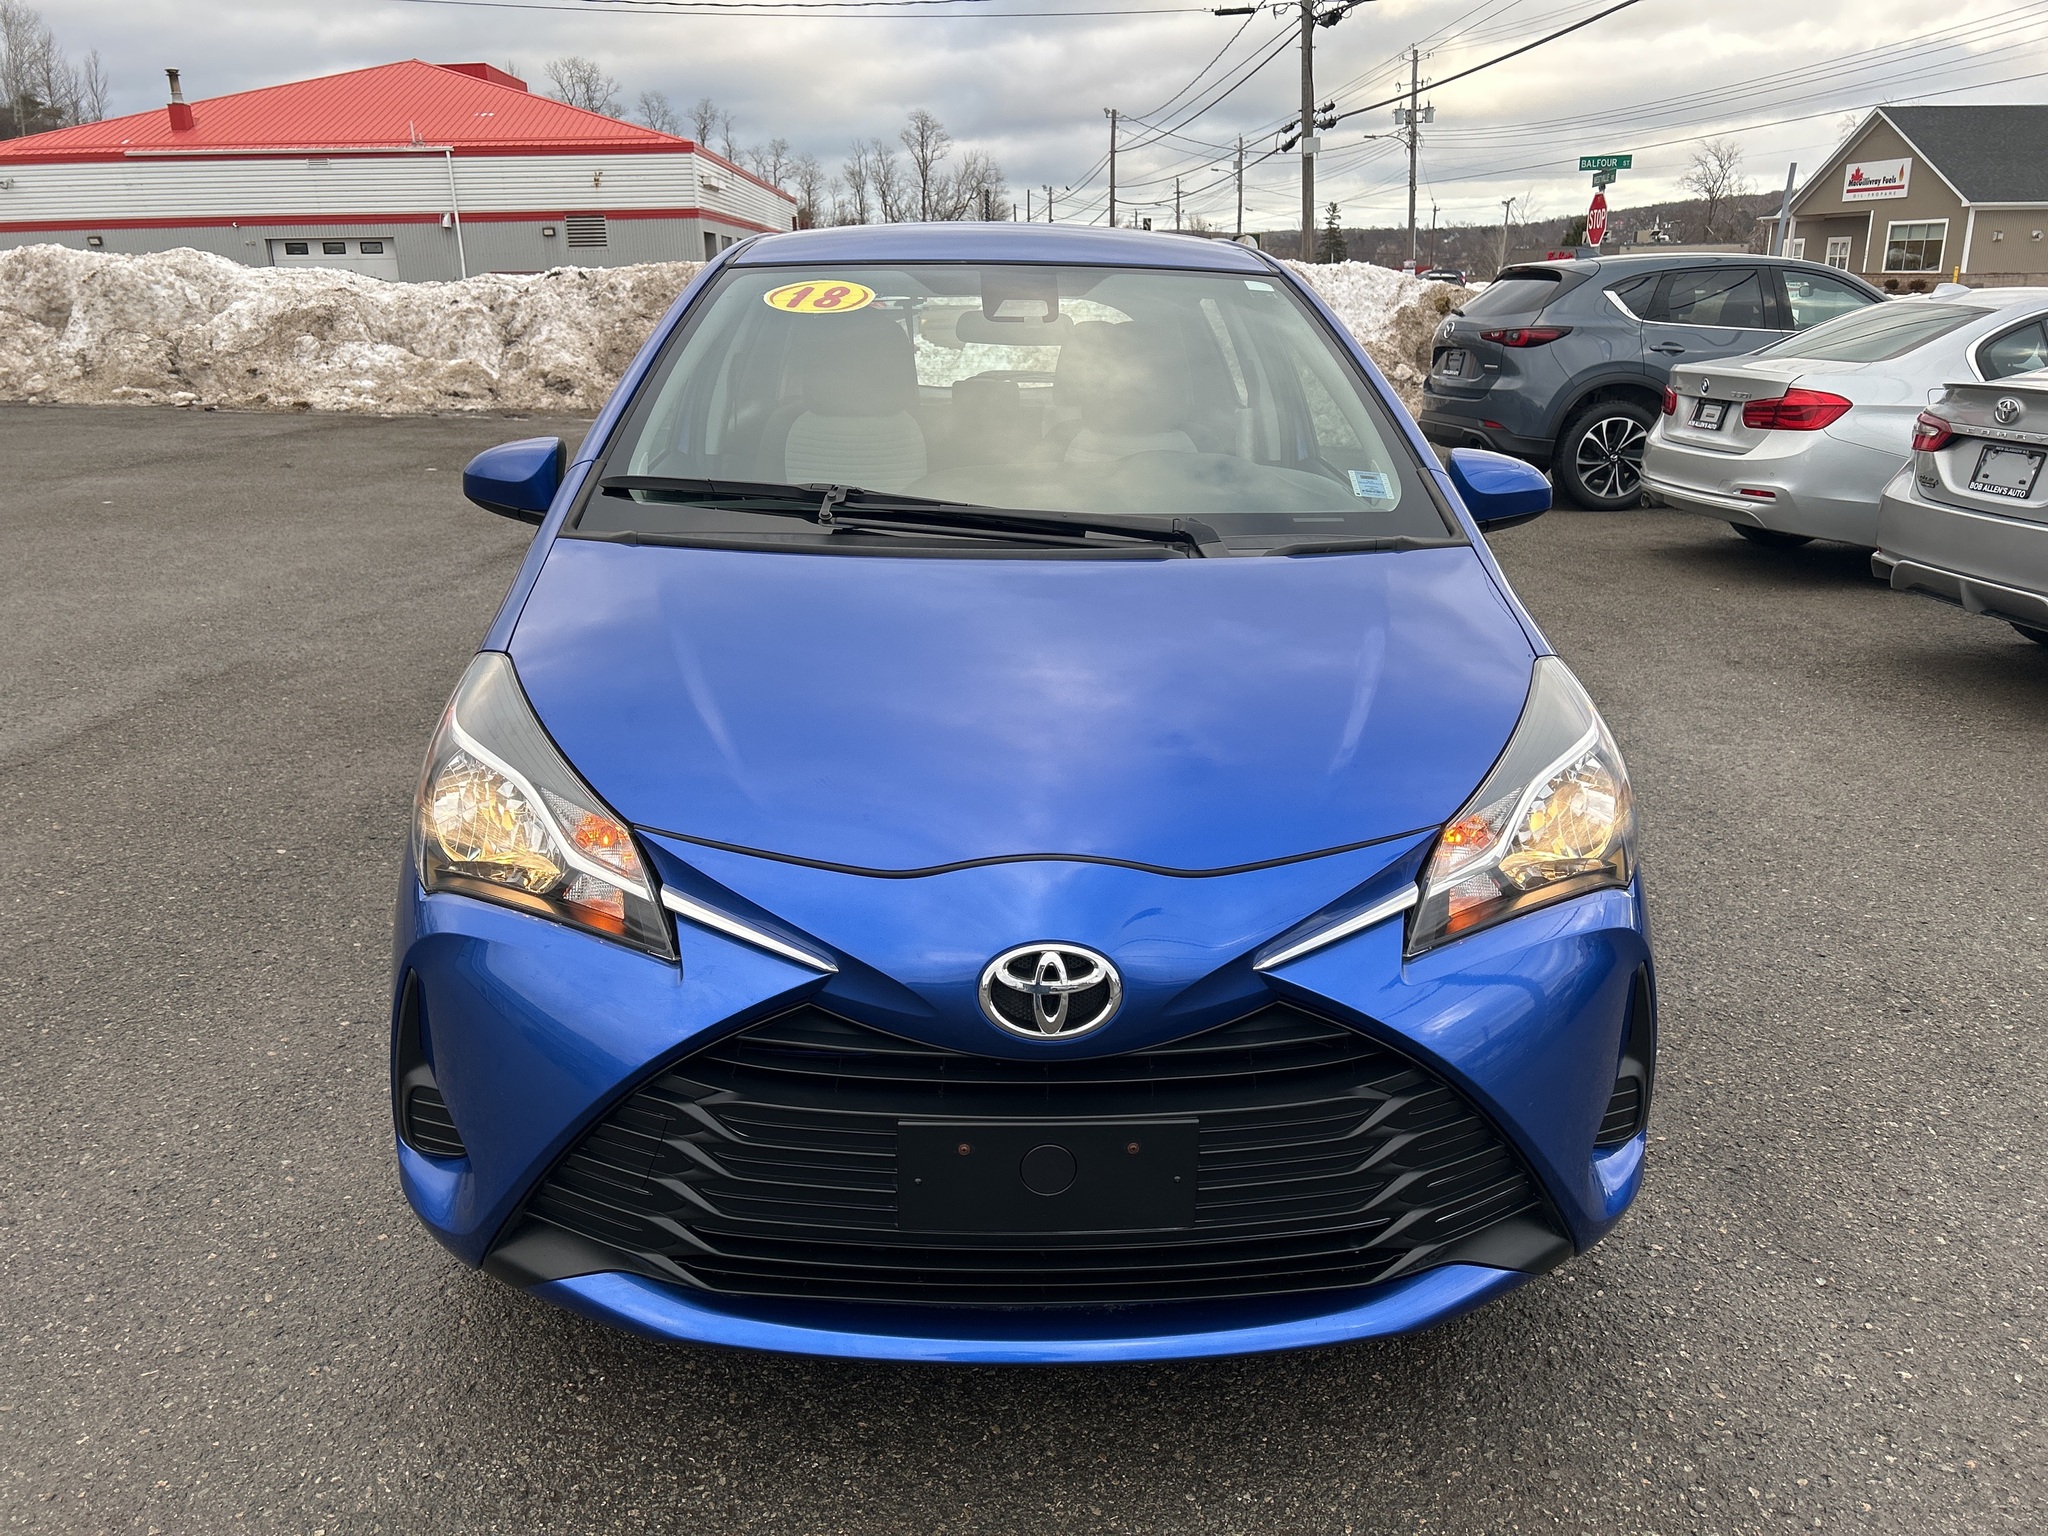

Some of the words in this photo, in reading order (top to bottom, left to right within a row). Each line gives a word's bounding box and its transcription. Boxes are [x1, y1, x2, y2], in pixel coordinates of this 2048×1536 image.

[1581, 158, 1618, 168] BALFOUR
[1882, 175, 1897, 184] Fuels
[1588, 208, 1606, 230] STOP
[786, 286, 851, 308] 18
[1969, 481, 1984, 491] BOB
[1983, 484, 2008, 495] ALLEN'S
[2007, 489, 2026, 498] AUTO
